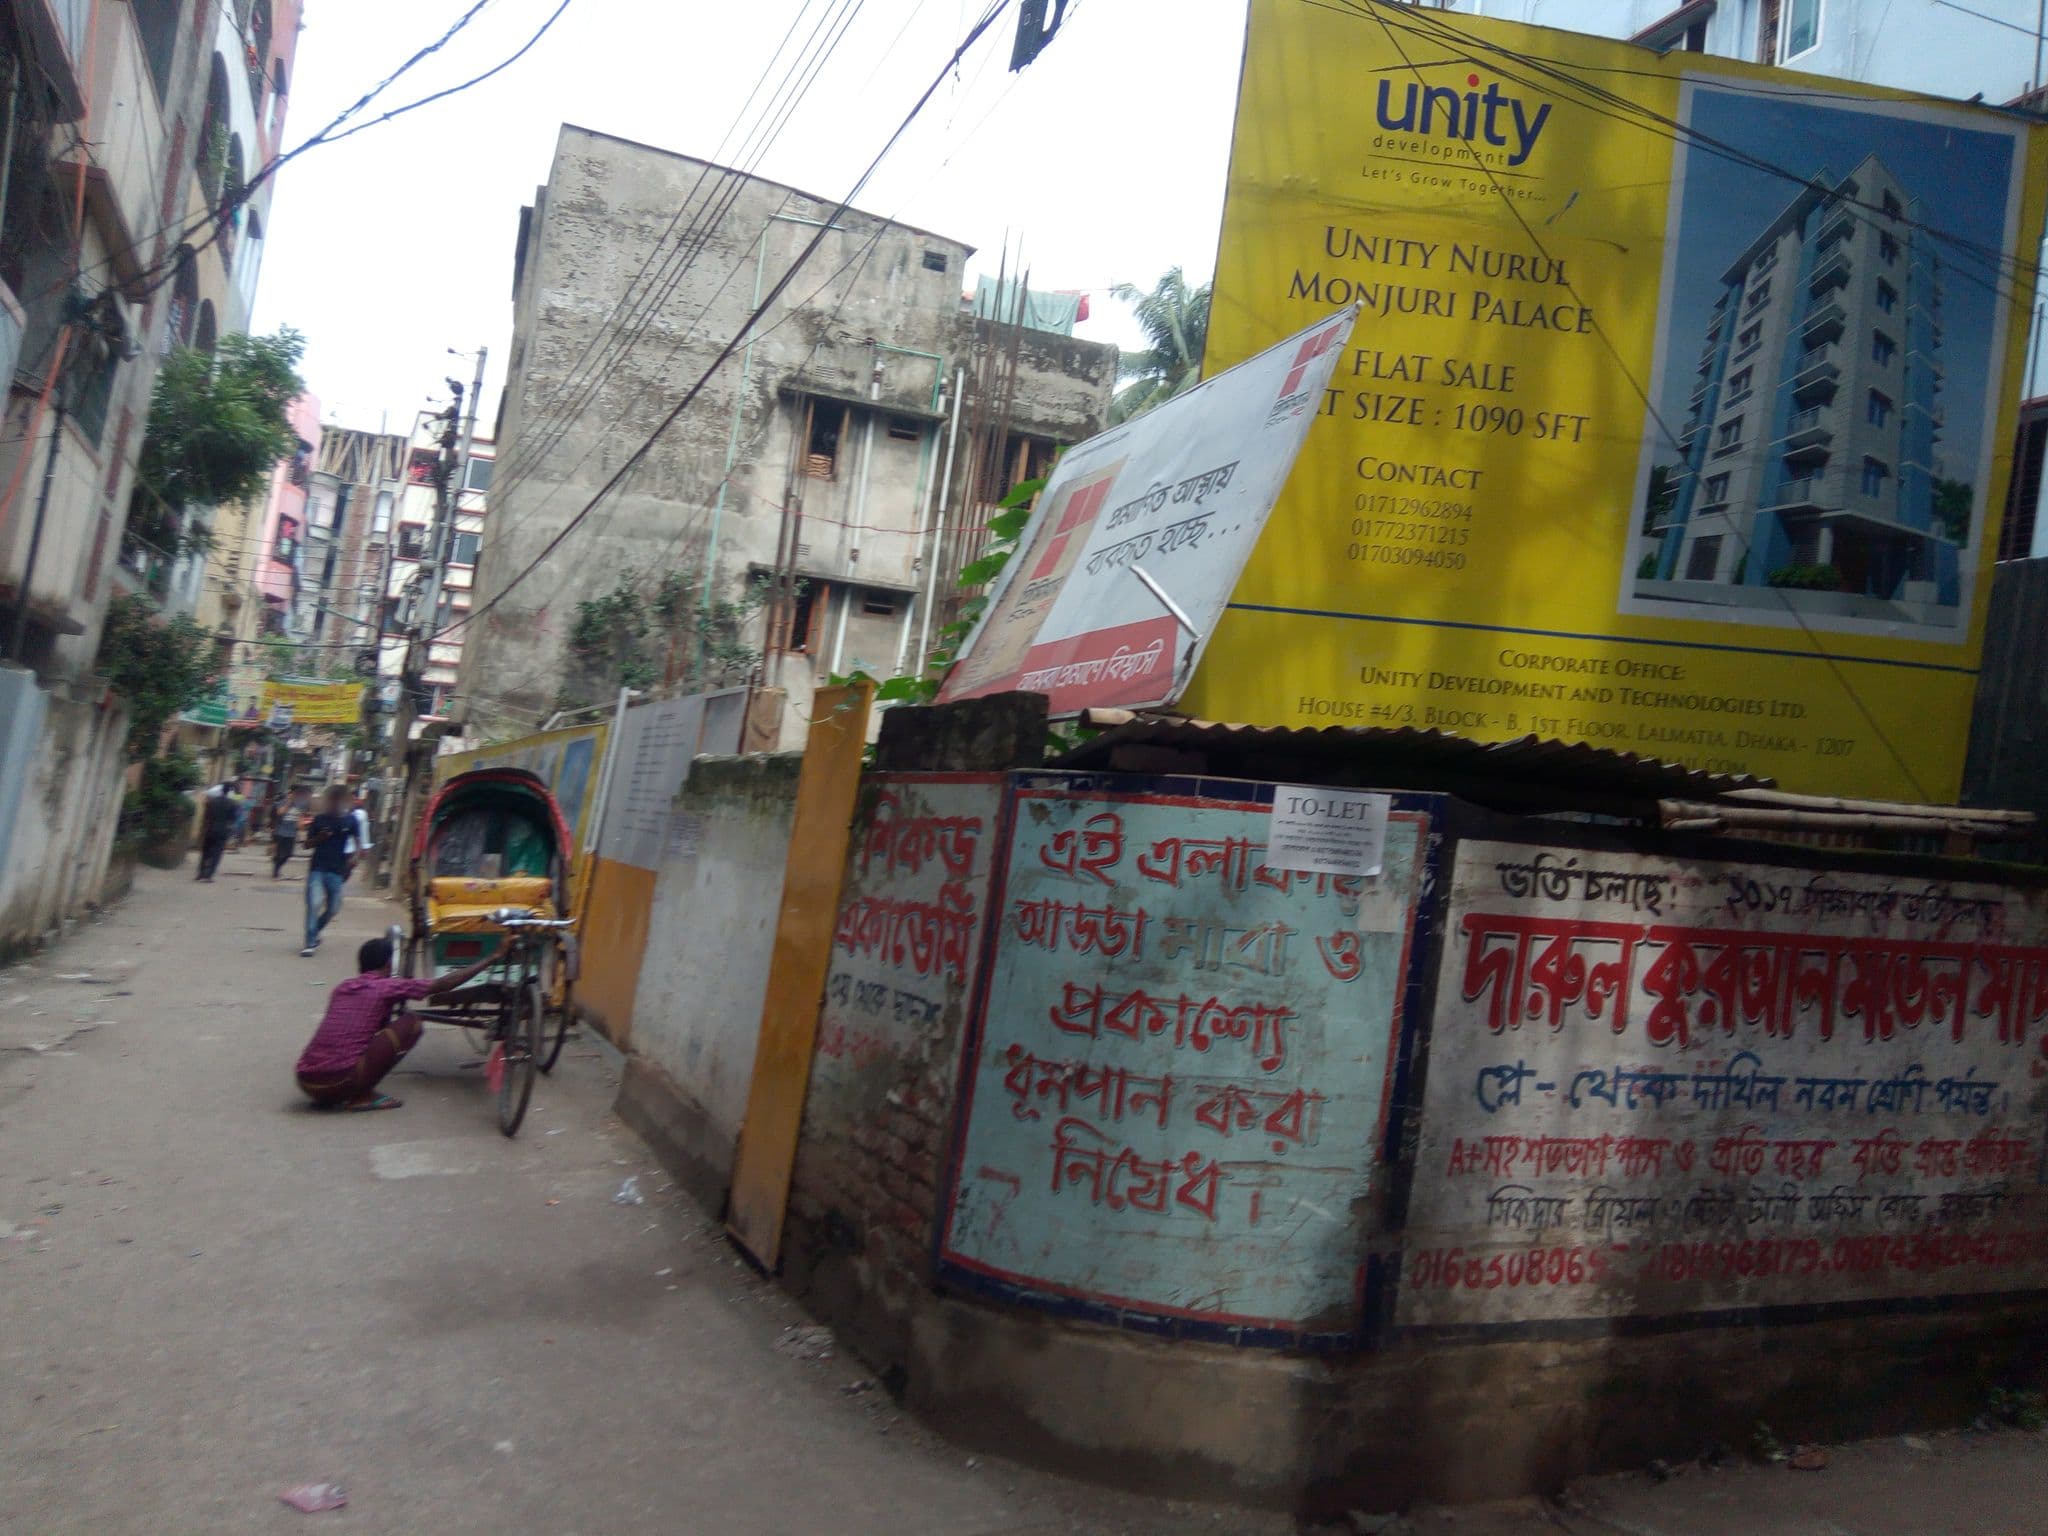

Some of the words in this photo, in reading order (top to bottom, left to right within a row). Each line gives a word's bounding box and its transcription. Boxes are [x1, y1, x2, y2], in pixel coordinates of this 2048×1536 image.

[1376, 73, 1553, 167] unity
[1372, 134, 1505, 166] development
[1410, 171, 1453, 188] Grow
[1325, 225, 1440, 269] UNITY
[1448, 242, 1571, 287] NURUL
[1287, 268, 1457, 319] MONJURI
[1469, 290, 1594, 335] PALACE
[1352, 349, 1432, 384] FLAT
[1441, 358, 1516, 393] SALE
[1353, 392, 1426, 427] SIZE
[1453, 403, 1525, 436] 1090
[1533, 411, 1591, 443] SFT
[1356, 456, 1483, 491] CONTACT
[1354, 494, 1473, 522] 01712962894
[1499, 649, 1610, 676] CORPORATE
[1297, 697, 1364, 719] HOUSE
[1424, 706, 1488, 729] BLOCK
[1359, 666, 1424, 689] UNITY
[1428, 672, 1566, 702] DEVELOPMENT
[1570, 687, 1614, 704] AND
[1619, 688, 1765, 717] TECHNOLOGIES
[1287, 797, 1372, 821] TO-LET
[1039, 812, 1128, 888] এই
[1494, 853, 1583, 901] ভর্তি
[1314, 929, 1367, 983] ও
[1462, 911, 1644, 1034] দারুল
[1048, 980, 1299, 1072] প্রকাশ্যে
[1569, 1065, 1688, 1110] থেকে
[1192, 1083, 1328, 1156] করা
